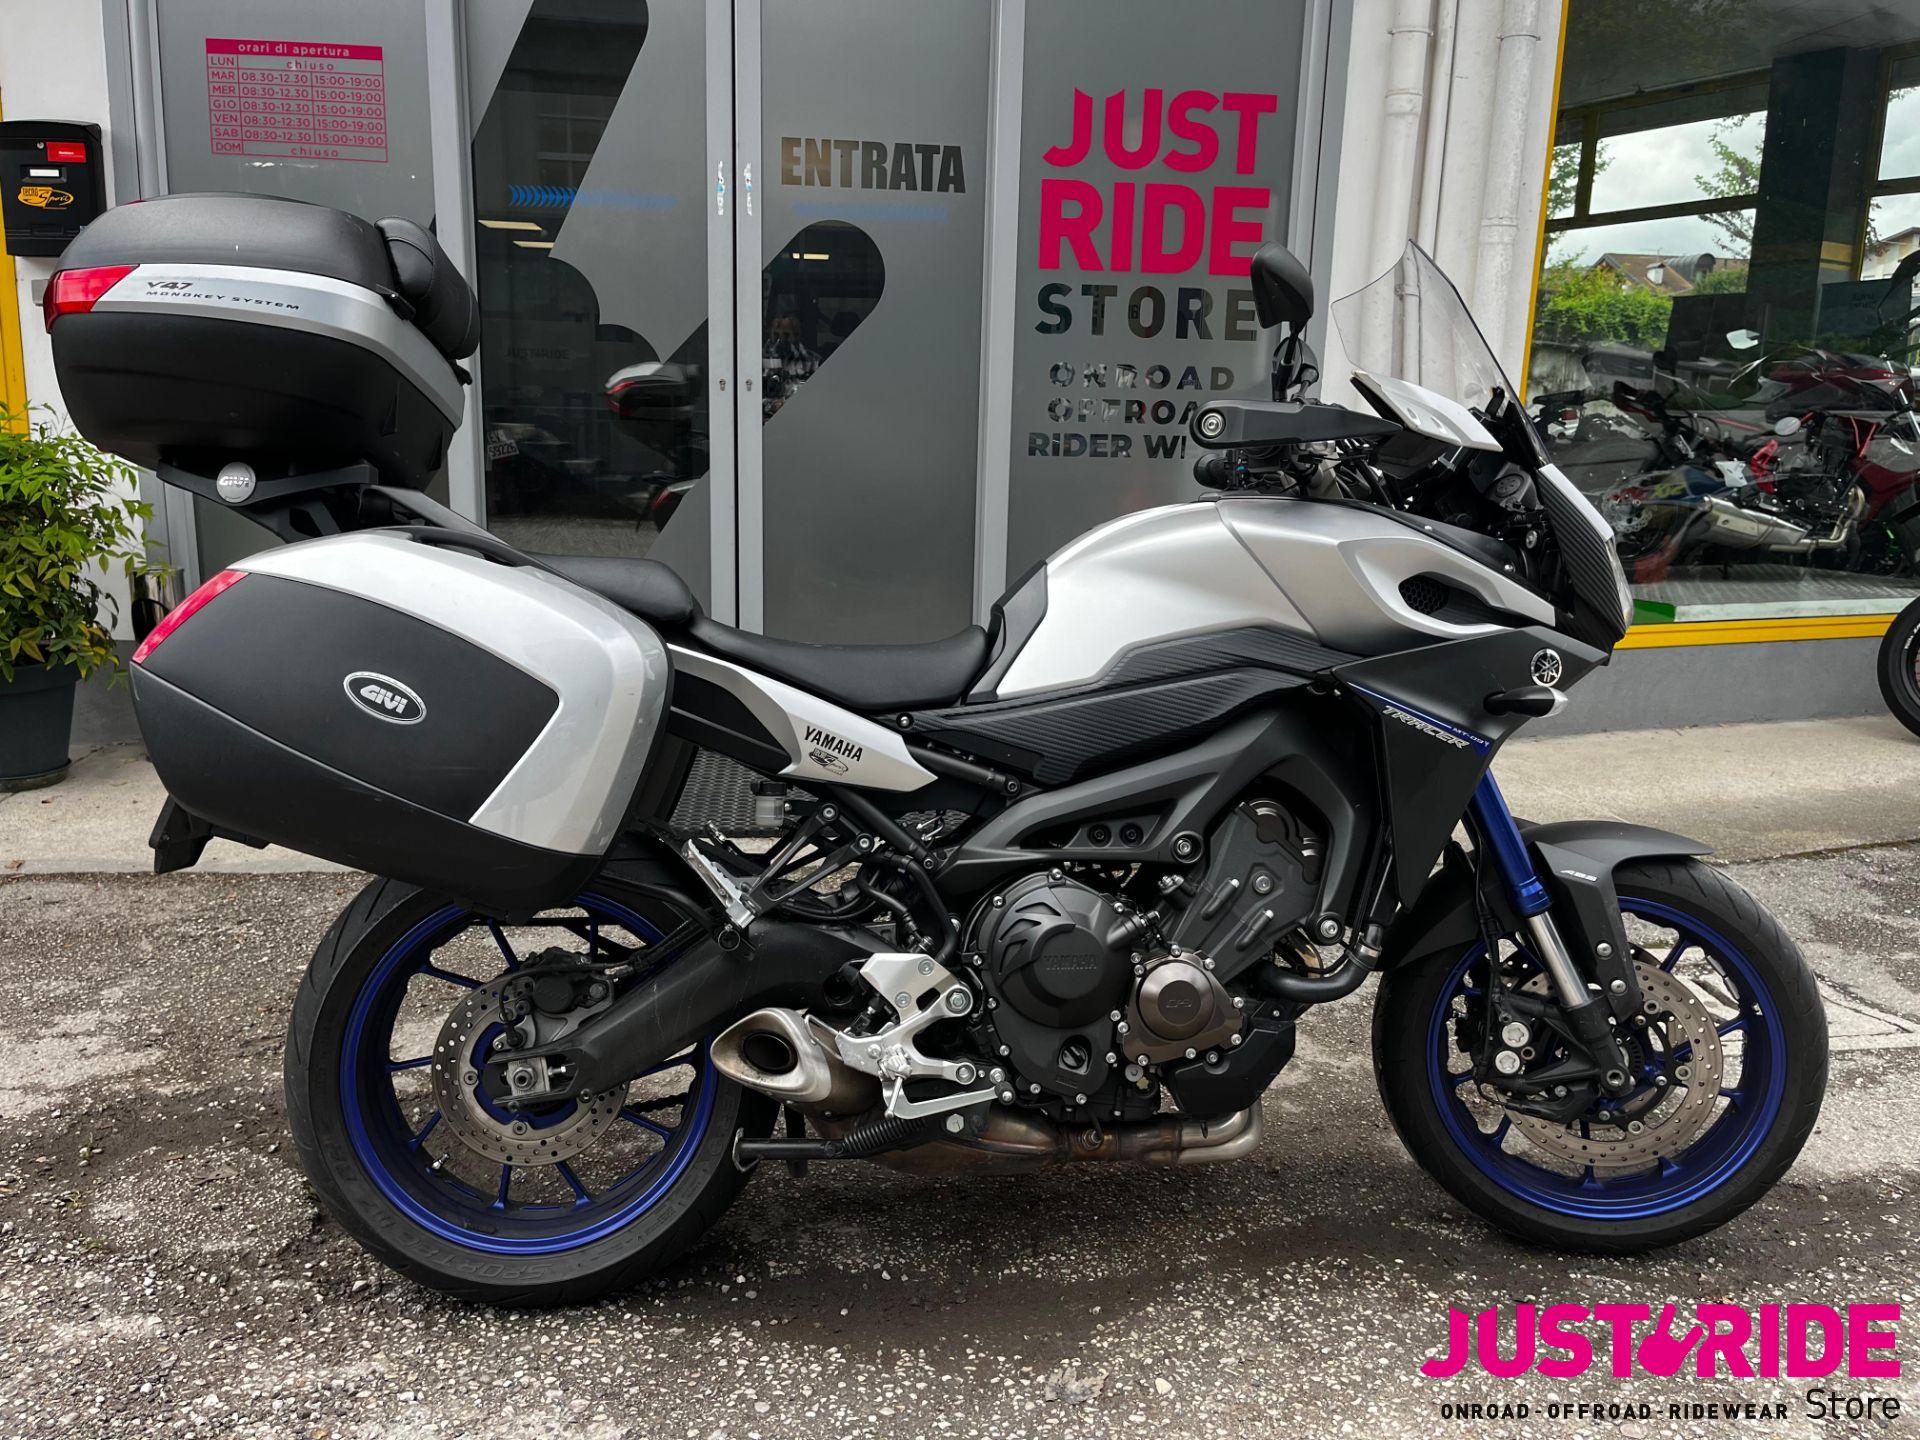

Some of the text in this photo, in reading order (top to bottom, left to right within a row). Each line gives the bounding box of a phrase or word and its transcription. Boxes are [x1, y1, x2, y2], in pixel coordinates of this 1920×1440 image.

[238, 42, 350, 58] orari di apertura
[210, 56, 334, 72] LUN chiuso
[211, 70, 236, 81] MAR
[212, 84, 236, 95] MER
[213, 100, 236, 109] GIO
[213, 113, 239, 123] VEN
[215, 127, 239, 138] SAB
[1042, 87, 1278, 175] JUST
[216, 142, 339, 158] DOM chiuso
[781, 136, 966, 193] ENTRATA
[1038, 178, 1271, 277] RIDE
[147, 281, 194, 290] V47
[146, 290, 300, 311] MONOKEY SYSTEM
[1034, 282, 1258, 342] STORE
[1050, 361, 1236, 391] ONROAD
[1027, 432, 1133, 458] RIDER
[360, 684, 408, 714] GIVI
[1382, 705, 1470, 749] TRACER
[804, 725, 864, 762] YAMAHA
